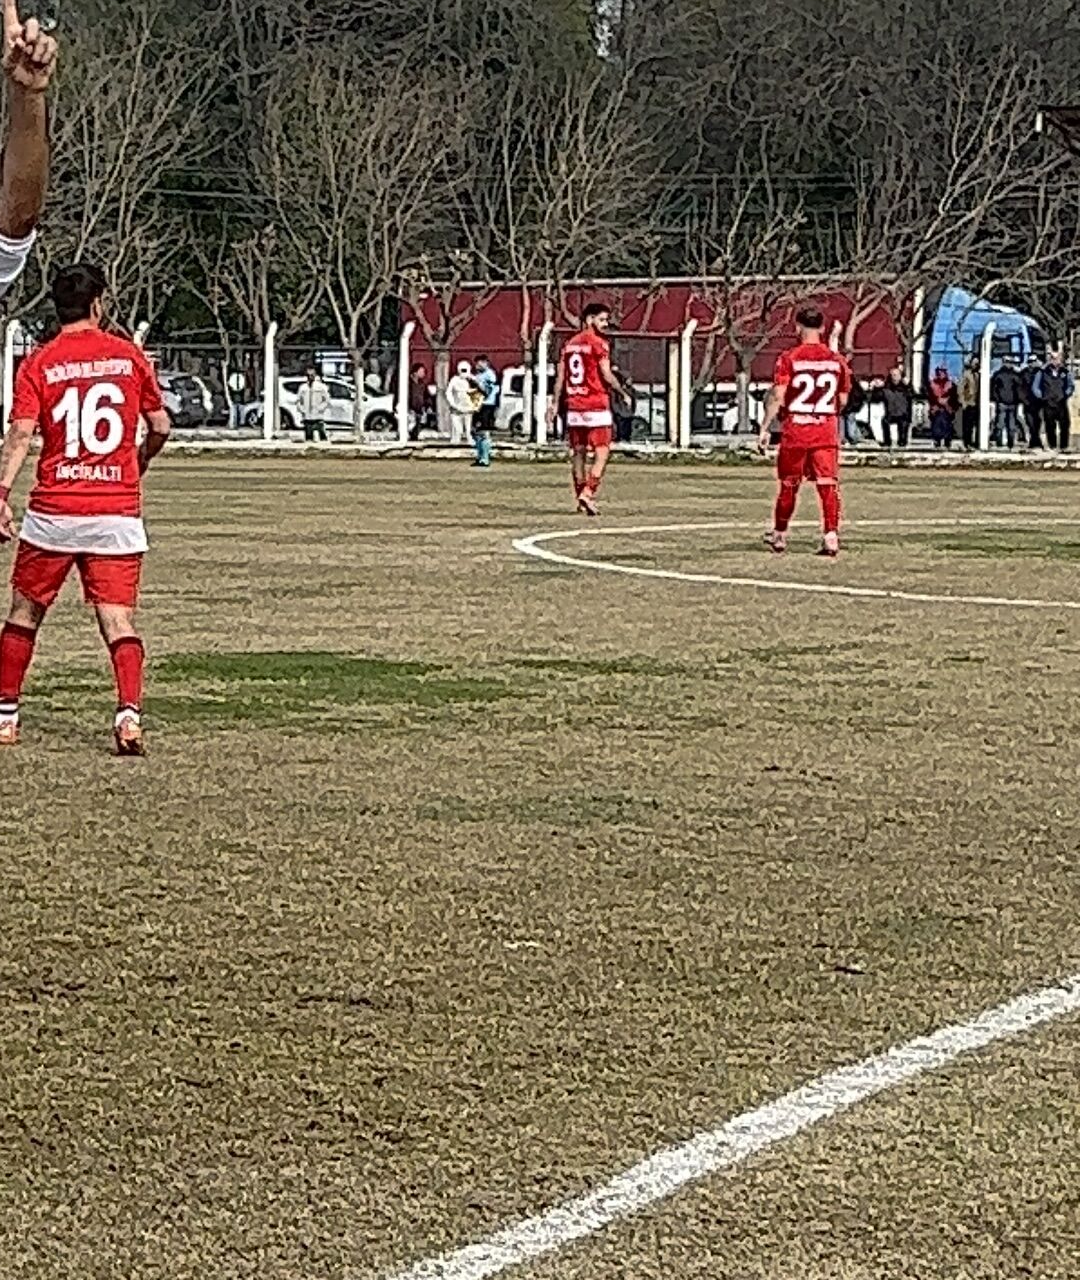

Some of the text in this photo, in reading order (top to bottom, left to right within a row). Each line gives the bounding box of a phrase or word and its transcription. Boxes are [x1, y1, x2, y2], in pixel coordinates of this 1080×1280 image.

[569, 353, 584, 384] 9
[788, 372, 837, 413] 22
[51, 382, 125, 458] 16
